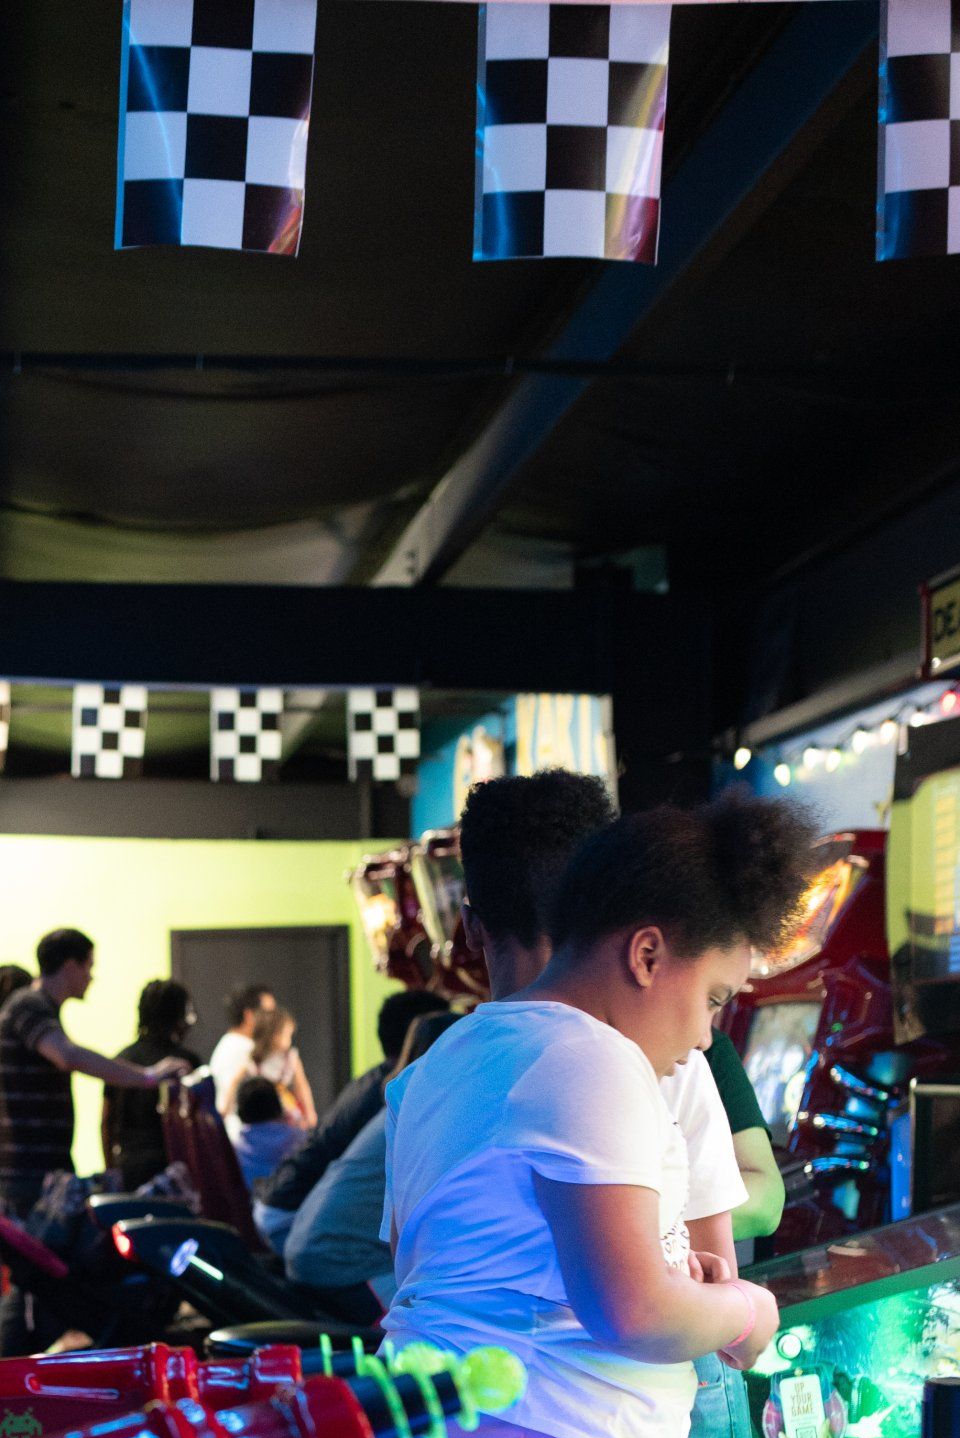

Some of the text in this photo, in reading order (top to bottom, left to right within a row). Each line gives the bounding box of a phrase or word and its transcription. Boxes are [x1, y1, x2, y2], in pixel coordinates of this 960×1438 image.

[794, 1382, 805, 1393] UP
[790, 1392, 813, 1405] YOUR
[791, 1404, 814, 1417] GAME
